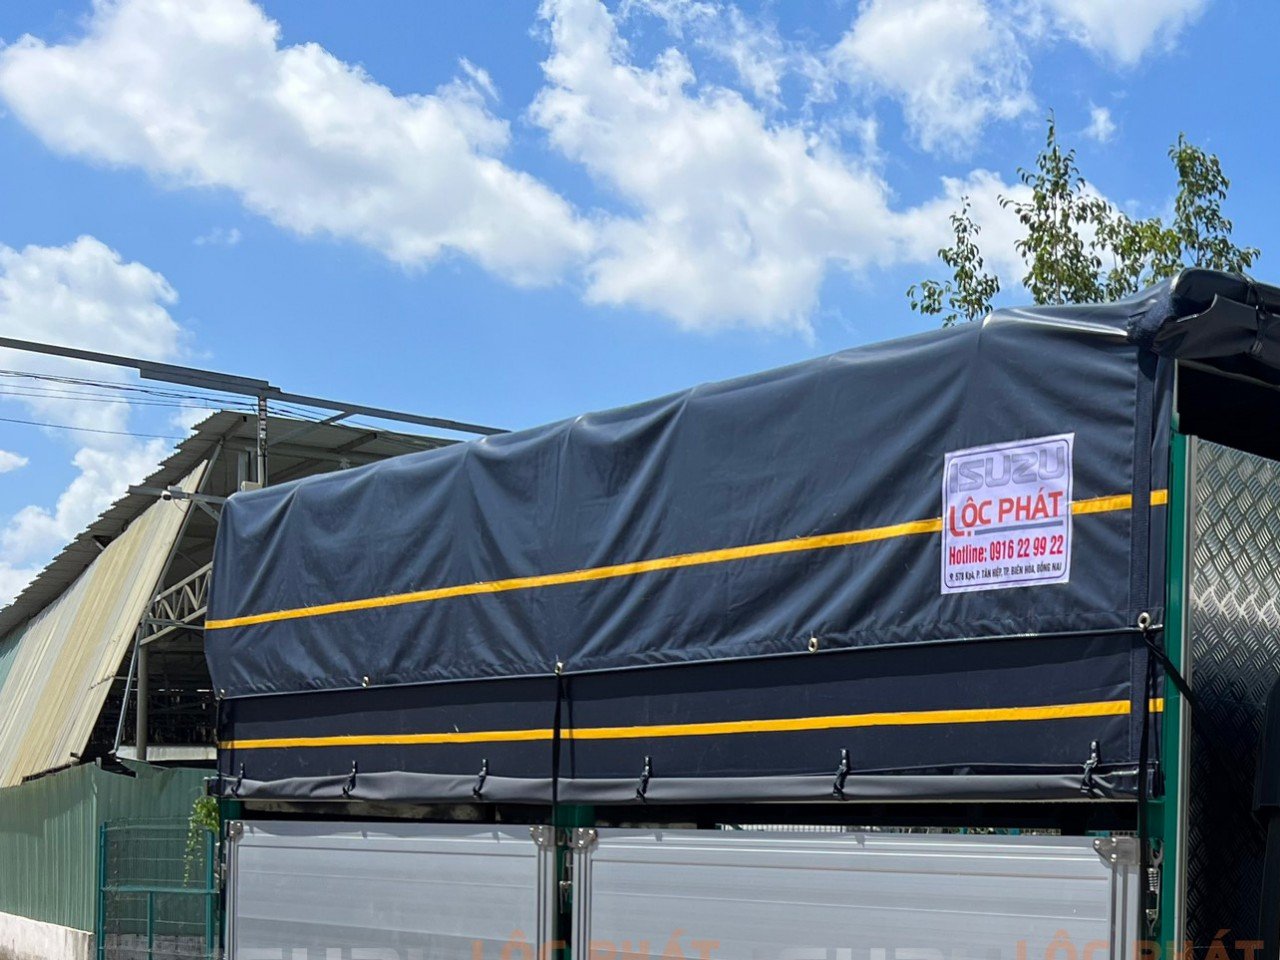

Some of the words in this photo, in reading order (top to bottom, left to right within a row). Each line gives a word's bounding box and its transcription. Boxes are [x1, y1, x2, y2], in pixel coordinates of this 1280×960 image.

[949, 446, 1066, 493] ISUZU
[949, 496, 992, 538] LỘC
[998, 487, 1063, 523] PHÁT
[949, 544, 987, 565] Hotline:
[990, 539, 1014, 561] 0916
[1017, 538, 1030, 558] 22
[1033, 536, 1047, 556] 99
[1049, 535, 1063, 555] 22
[1052, 563, 1062, 571] NAI
